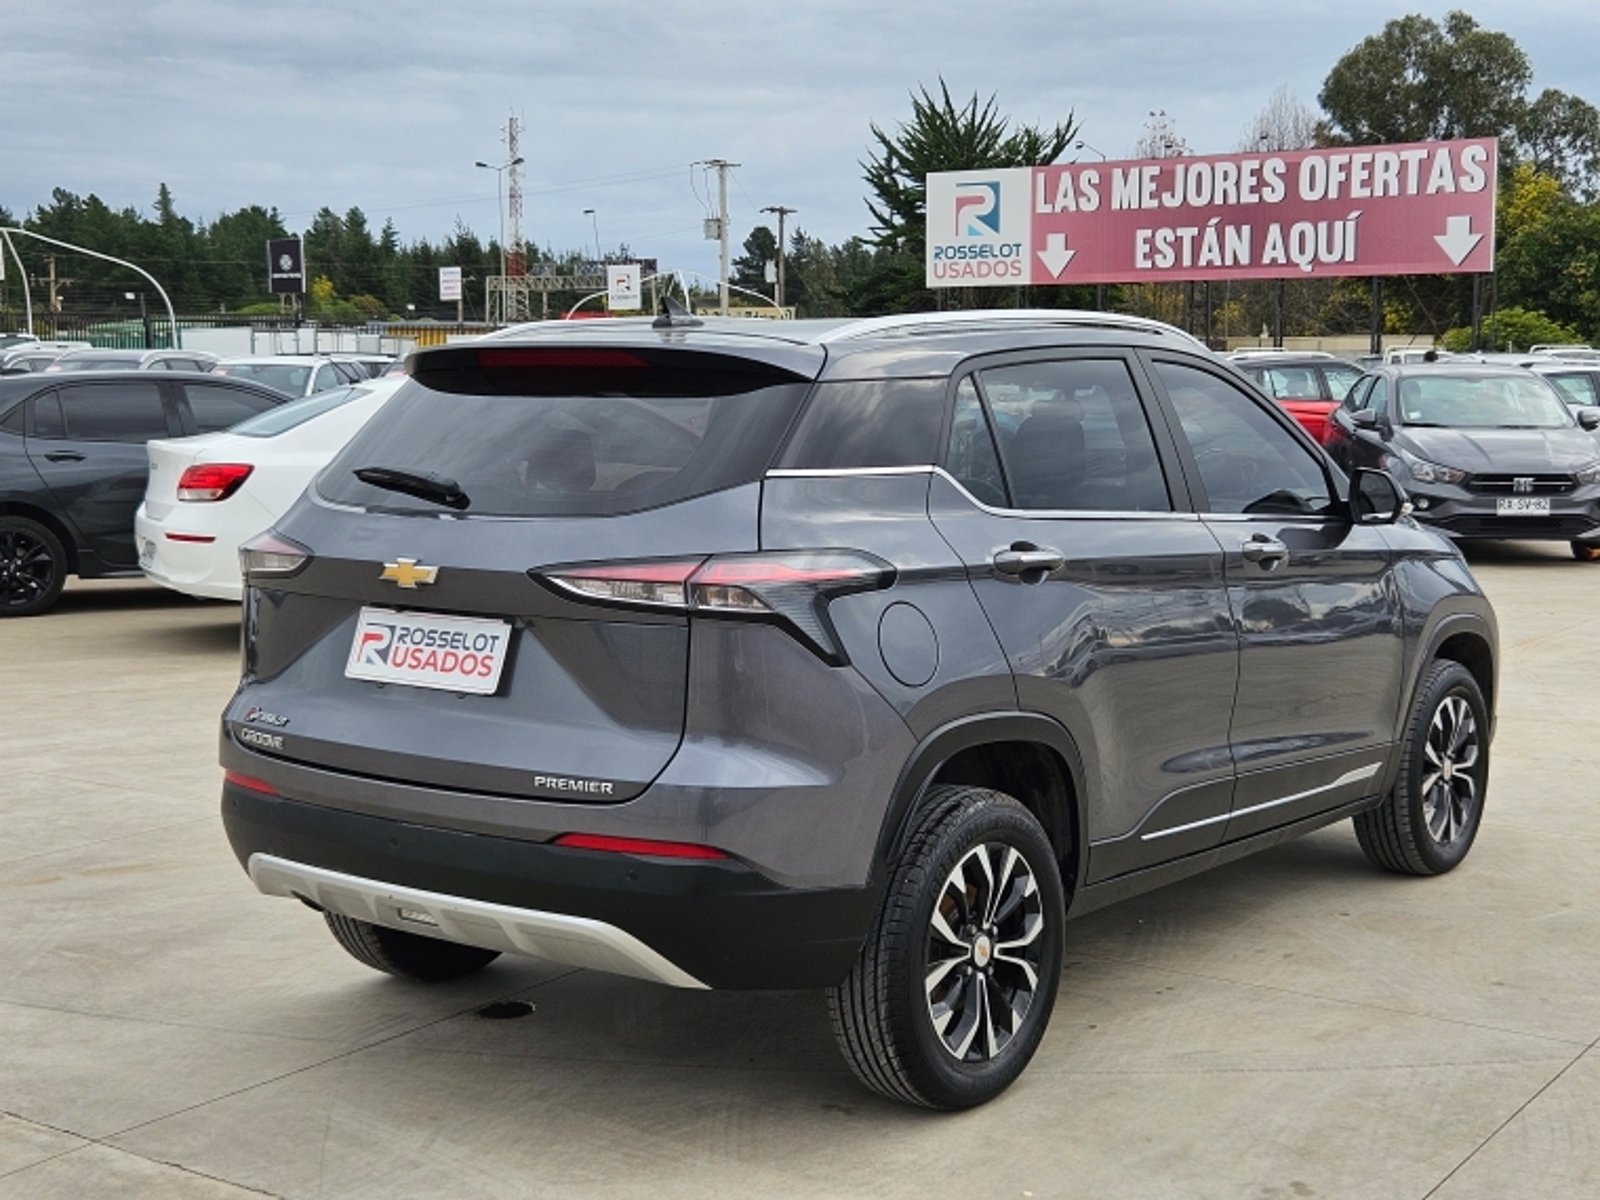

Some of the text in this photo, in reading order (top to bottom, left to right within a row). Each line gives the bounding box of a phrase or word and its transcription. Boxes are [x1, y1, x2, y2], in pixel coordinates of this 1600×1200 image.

[1035, 144, 1488, 214] LAS MEJORES OFERTAS
[934, 243, 1022, 260] ROSSELOT
[1135, 210, 1364, 272] ESTÁN AQUÍ
[934, 260, 1022, 279] USADOS
[396, 626, 501, 653] ROSSELOT
[391, 646, 495, 677] USADOS
[533, 776, 614, 795] PREMIER
